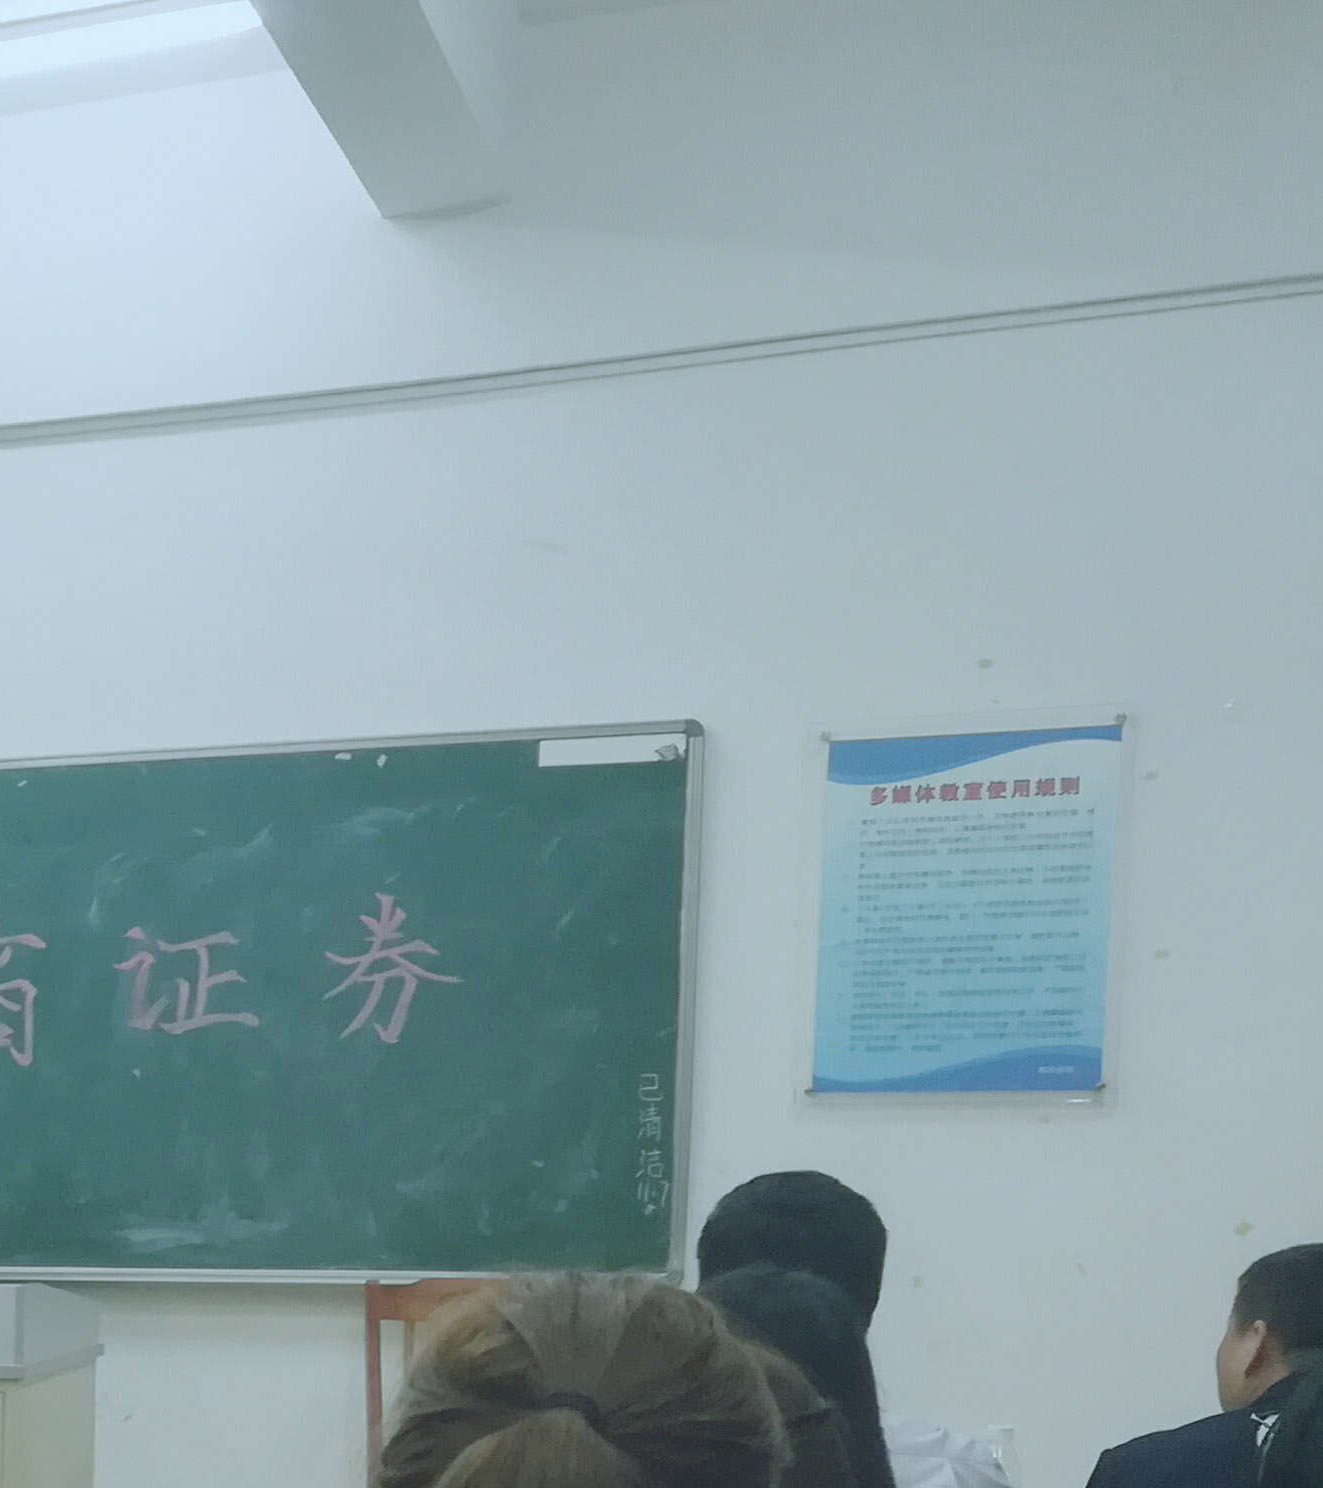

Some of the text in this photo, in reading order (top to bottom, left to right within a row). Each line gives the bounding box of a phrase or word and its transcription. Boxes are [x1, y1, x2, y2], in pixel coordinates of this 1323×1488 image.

[870, 776, 1080, 806] 多媒体教室使用规则
